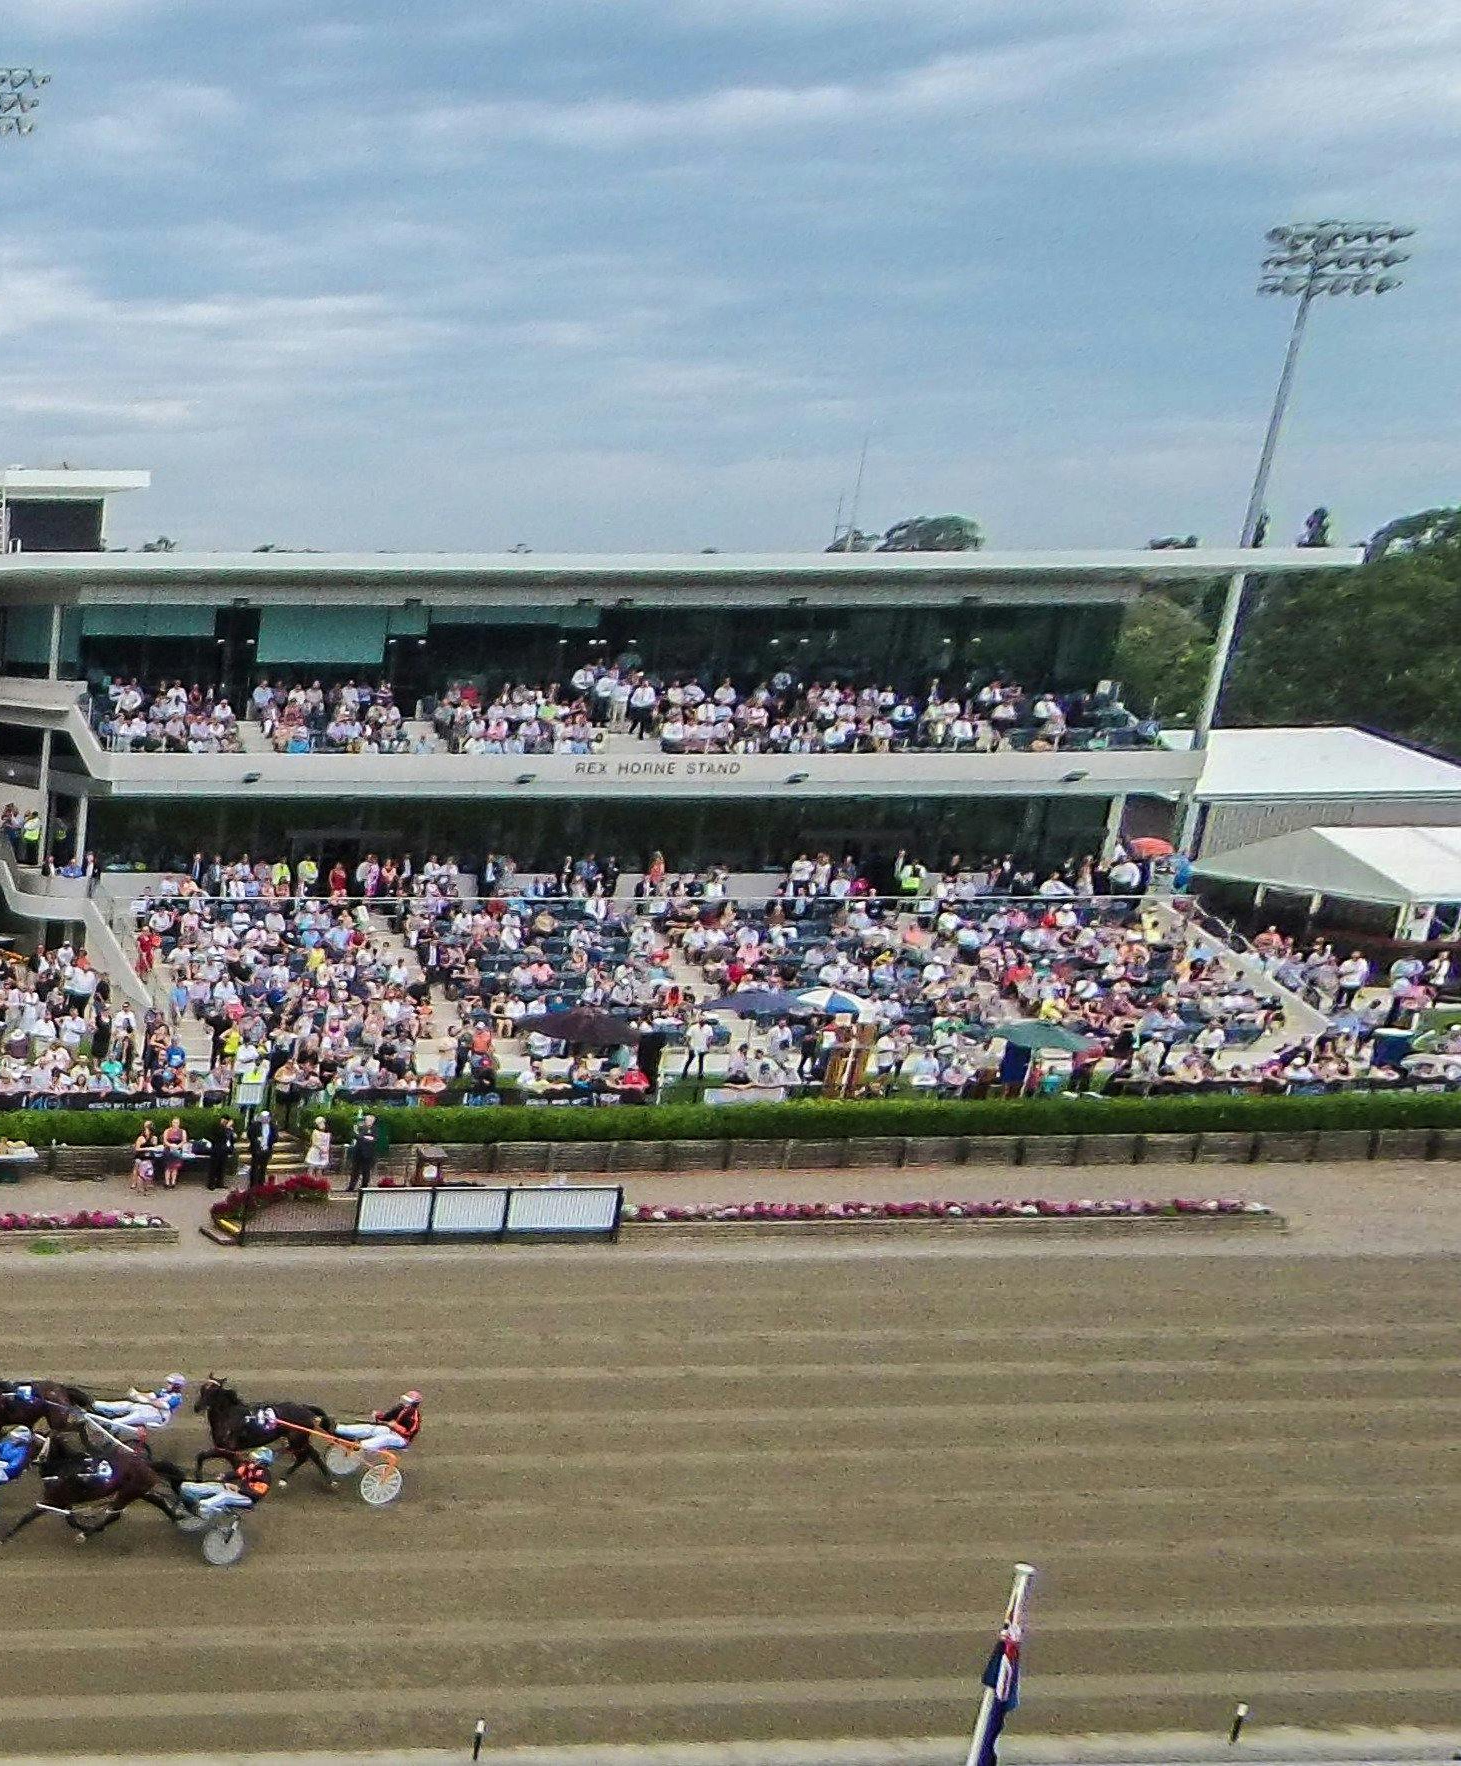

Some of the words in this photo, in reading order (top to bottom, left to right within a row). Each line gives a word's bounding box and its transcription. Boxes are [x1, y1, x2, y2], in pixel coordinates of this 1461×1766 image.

[575, 762, 607, 775] REX
[618, 762, 676, 775] HORNE
[686, 762, 741, 775] STAND
